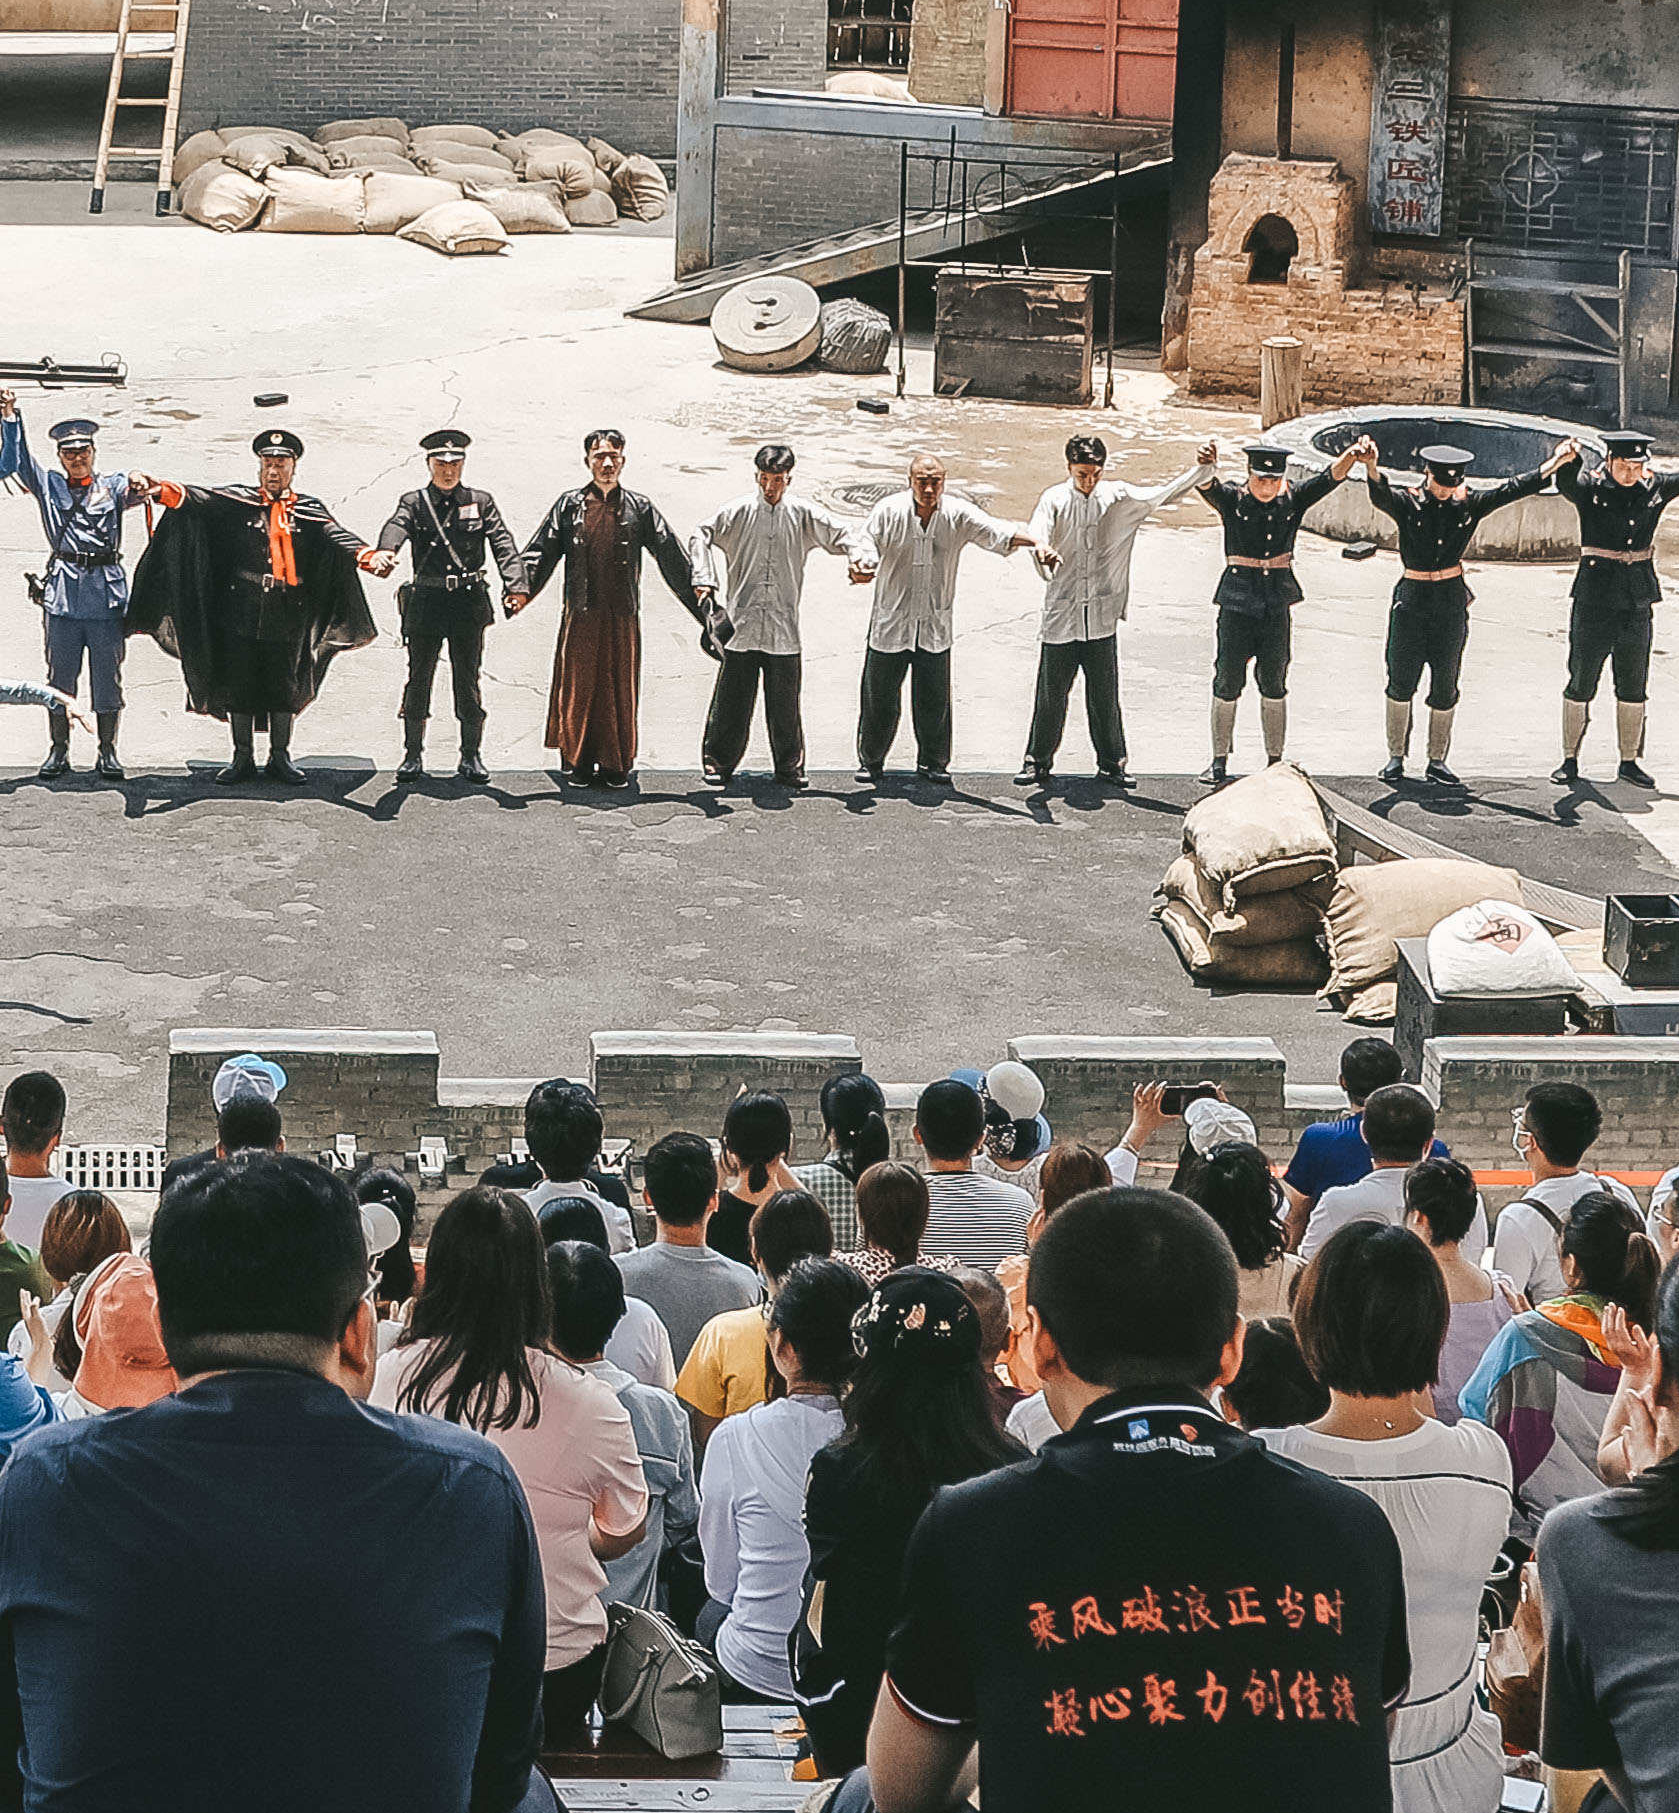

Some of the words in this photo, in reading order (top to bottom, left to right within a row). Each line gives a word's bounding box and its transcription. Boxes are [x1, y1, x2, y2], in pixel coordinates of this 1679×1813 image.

[1029, 1585, 1346, 1651] 乘风破浪正当时
